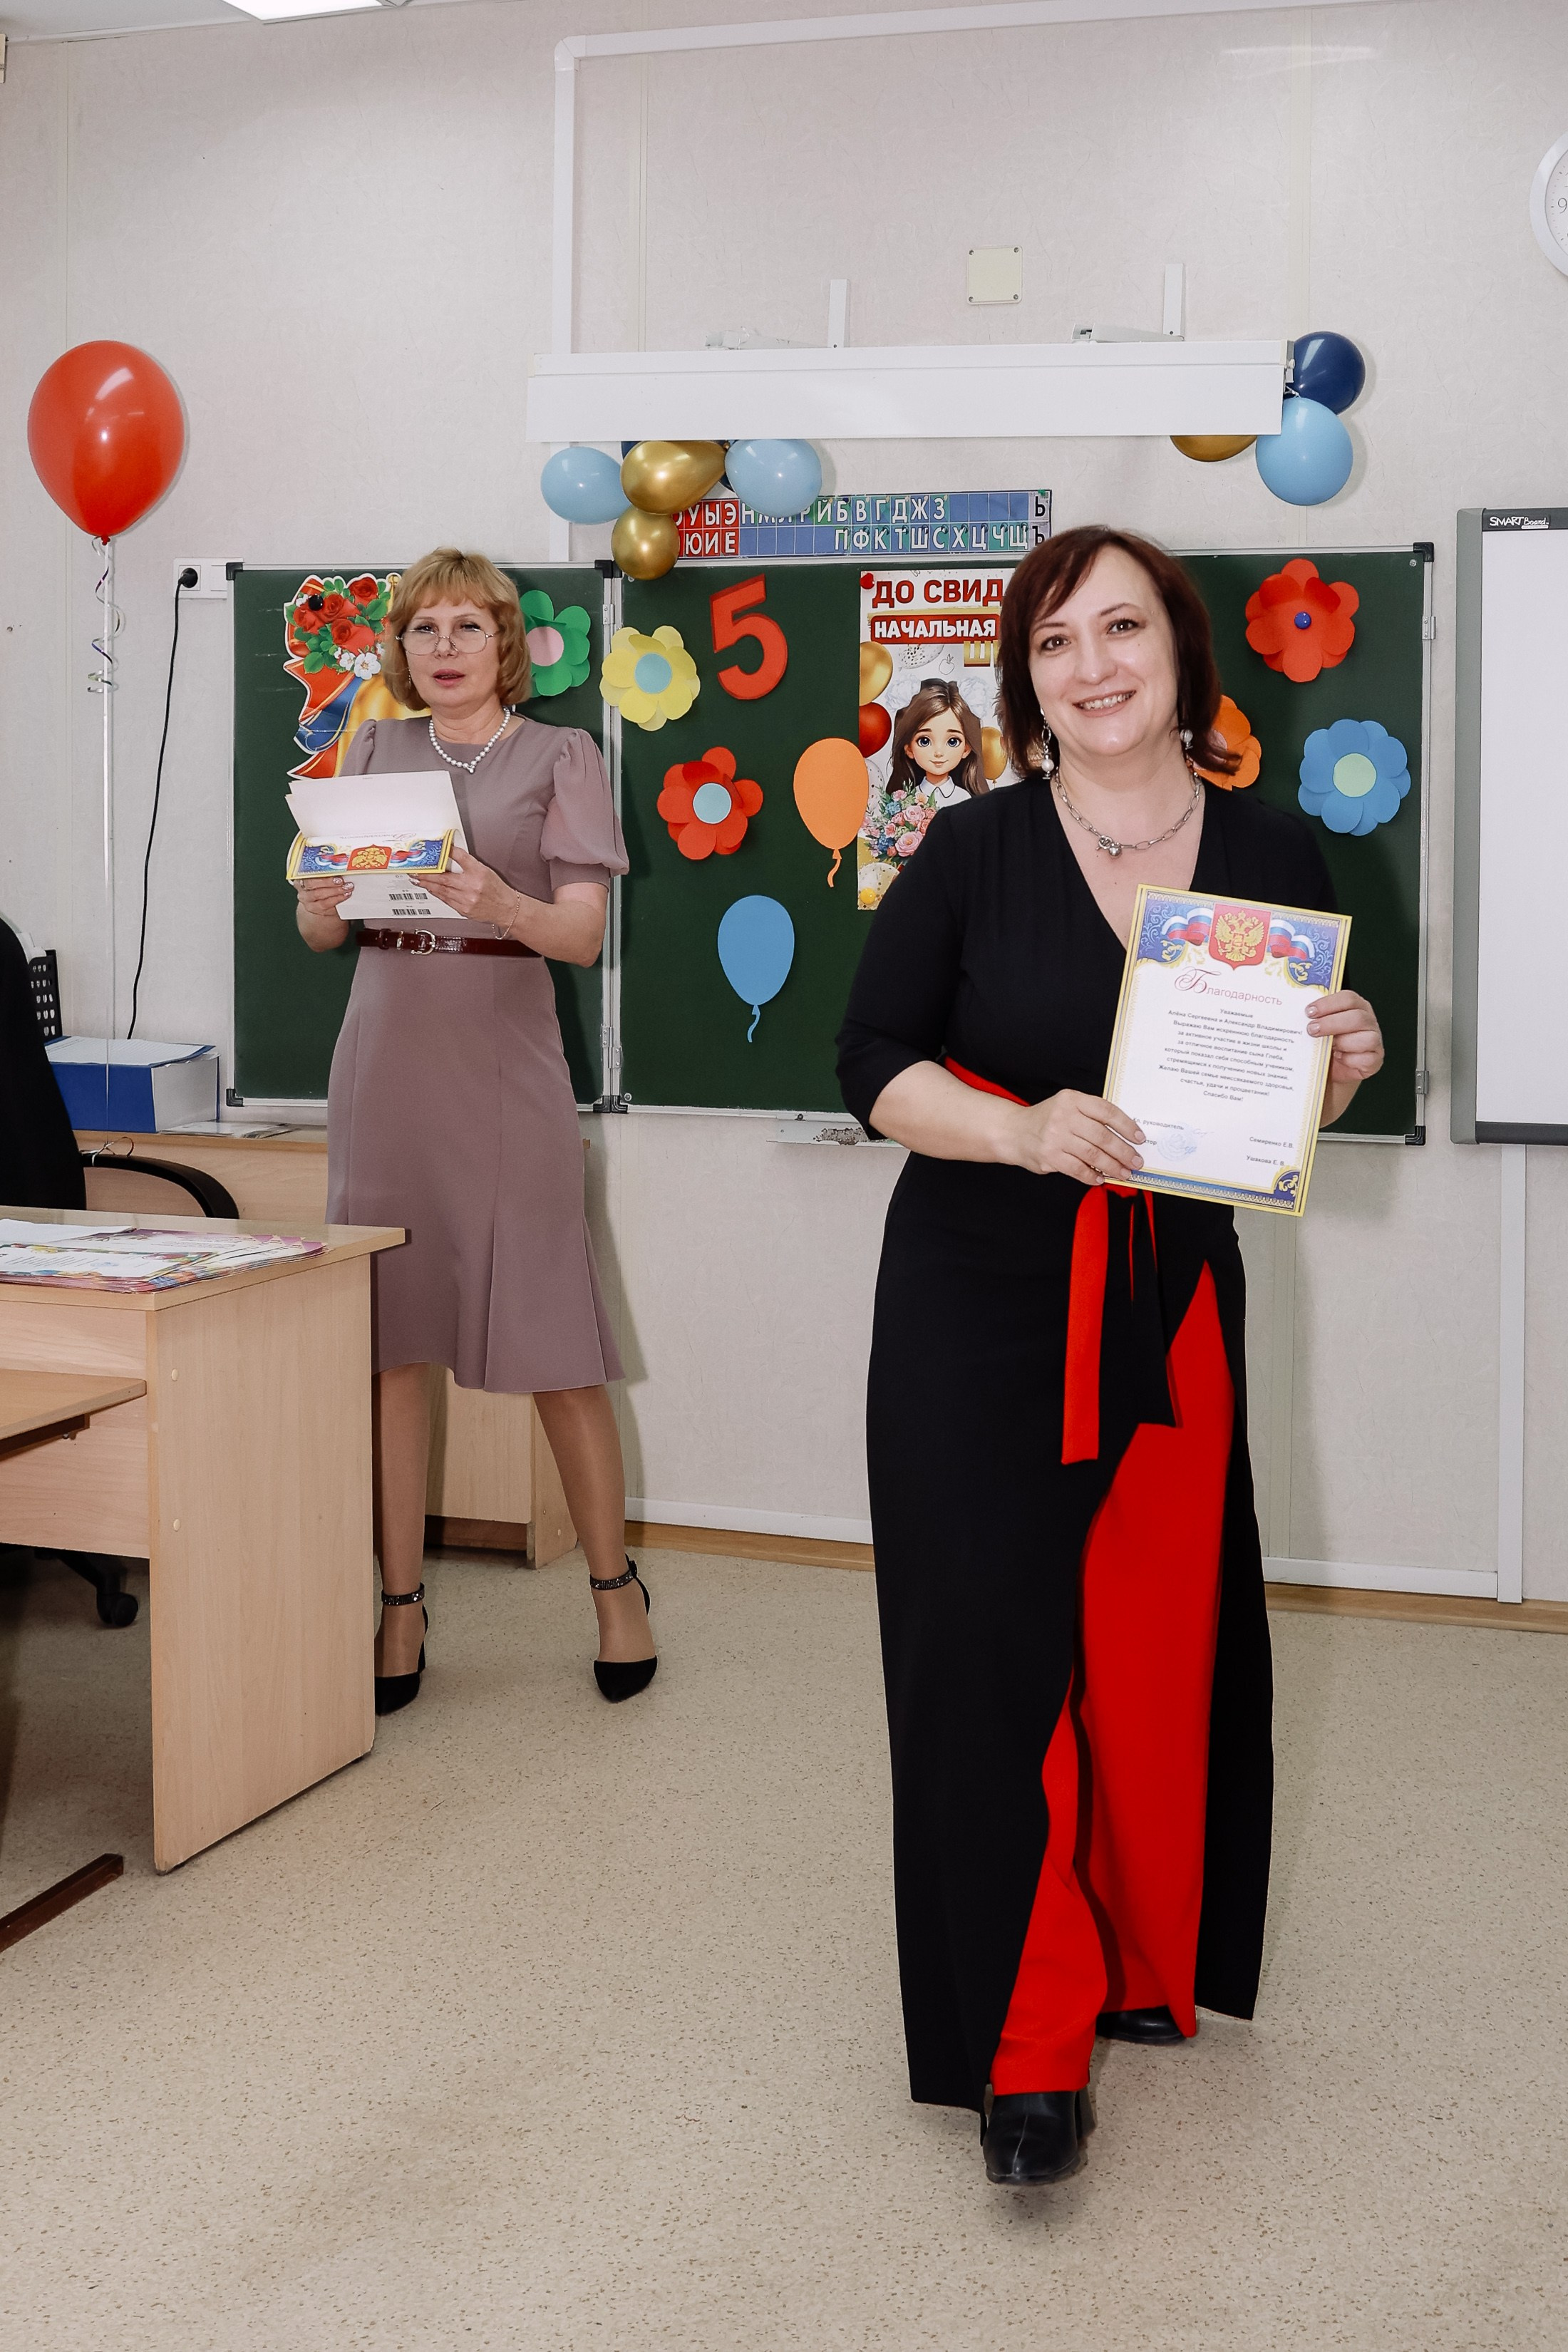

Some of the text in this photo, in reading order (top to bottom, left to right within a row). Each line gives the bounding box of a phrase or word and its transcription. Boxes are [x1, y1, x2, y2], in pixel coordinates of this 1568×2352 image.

[1490, 516, 1547, 526] SMART Board
[872, 579, 1004, 608] ДО СВИД
[708, 573, 788, 700] 5
[875, 619, 996, 639] НАЧАЛЬНАЯ
[1175, 966, 1282, 1006] Благодарность
[1220, 1009, 1254, 1018] Уважаемые
[1203, 1090, 1228, 1099] Спасибо
